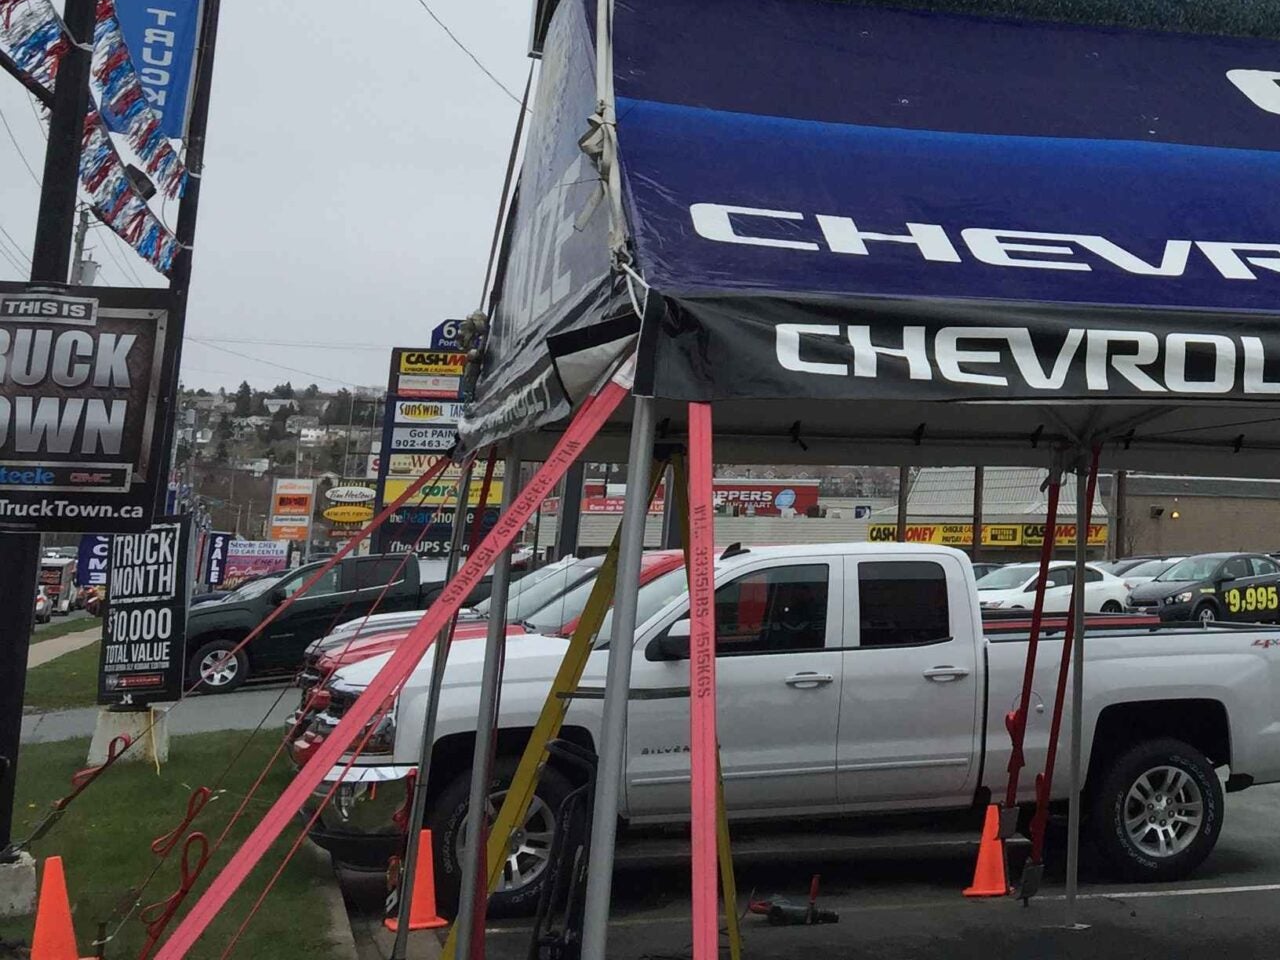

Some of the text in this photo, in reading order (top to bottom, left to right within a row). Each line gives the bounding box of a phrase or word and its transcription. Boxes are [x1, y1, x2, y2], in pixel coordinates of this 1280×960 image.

[5, 301, 86, 317] THIS IS
[409, 429, 428, 439] Got
[713, 490, 773, 501] PPERS
[870, 526, 896, 541] CASH
[903, 526, 936, 542] ONEY
[114, 531, 173, 567] TRUCK
[415, 541, 440, 553] UPS
[209, 536, 223, 583] SALE
[111, 565, 173, 596] MONTH
[1225, 586, 1278, 613] $9,995
[106, 641, 171, 664] TOTAL VALUE
